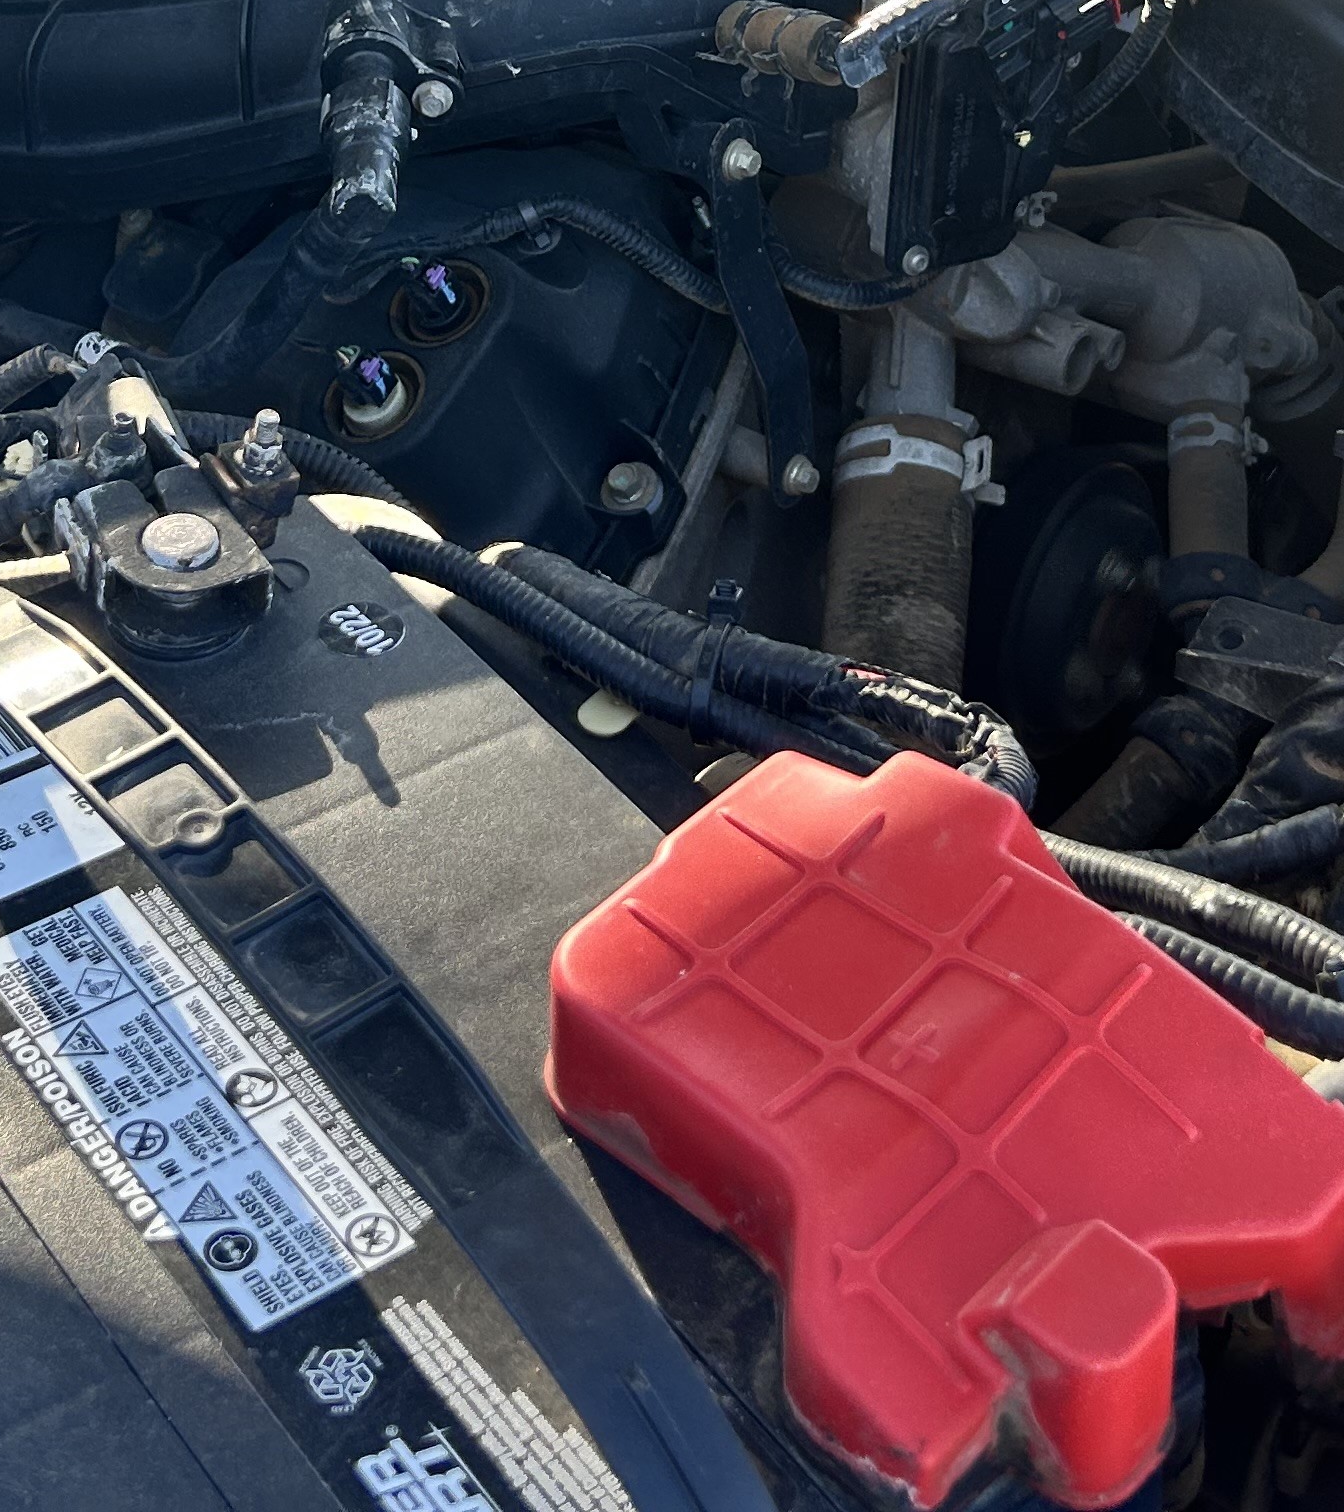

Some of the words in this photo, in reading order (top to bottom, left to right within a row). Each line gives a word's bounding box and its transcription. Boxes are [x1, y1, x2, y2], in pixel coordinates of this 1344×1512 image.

[15, 821, 37, 837] RC
[28, 809, 61, 834] 150
[55, 909, 89, 940] FAST.
[86, 903, 127, 943] BATTERY.
[127, 886, 176, 935] INCINERATE.
[21, 924, 49, 947] GET
[38, 916, 84, 962] MEDICAL
[76, 936, 109, 965] HELP
[164, 931, 186, 948] OR
[116, 940, 145, 965] OPEN
[149, 955, 175, 977] NOT
[191, 939, 236, 983] CHARGING
[21, 949, 62, 989] WATER.
[134, 962, 160, 983] NOT
[164, 973, 186, 990] DO
[175, 943, 231, 1001] DISASSEMBLE
[2, 956, 65, 1024] IMMEDIATELY
[50, 986, 83, 1016] WITH
[148, 979, 170, 997] DO
[225, 979, 263, 1015] PROPER
[11, 996, 48, 1032] FLUSH
[220, 997, 246, 1018] NOT
[118, 1019, 140, 1037] OR
[131, 1008, 169, 1045] BURNS.
[182, 995, 247, 1063] INSTRUCTIONS.
[186, 1025, 211, 1046] ALL
[234, 1014, 257, 1032] DO
[252, 1011, 291, 1049] FOLLOW
[112, 1041, 147, 1075] CAUSE
[128, 1033, 179, 1087] BLINDNESS
[157, 1041, 196, 1079] SEVERE
[201, 1043, 231, 1070] READ
[272, 1059, 294, 1077] OR
[74, 1058, 126, 1113] SULFURIC
[112, 1074, 145, 1104] ACID
[135, 1071, 162, 1095] CAN
[299, 1067, 344, 1112] INVERTED
[283, 1073, 334, 1124] EXPLOSION
[333, 1108, 359, 1130] FOR
[277, 1110, 329, 1163] CHILDREN.
[156, 1156, 183, 1178] NO
[291, 1153, 314, 1172] OF
[342, 1143, 365, 1161] OF
[303, 1167, 331, 1193] OUT
[317, 1159, 340, 1177] OF
[353, 1156, 384, 1184] RISK
[244, 1168, 299, 1227] BLINDNESS
[320, 1189, 352, 1218] KEEP
[329, 1172, 367, 1210] REACH
[405, 1193, 435, 1219] NOT
[233, 1187, 275, 1229] GASES
[288, 1222, 325, 1260] CAUSE
[303, 1214, 345, 1257] INJURY.
[263, 1225, 326, 1293] EXPLOSIVE
[315, 1256, 343, 1282] CAN
[334, 1253, 358, 1274] OR
[239, 1267, 286, 1315] SHIELD
